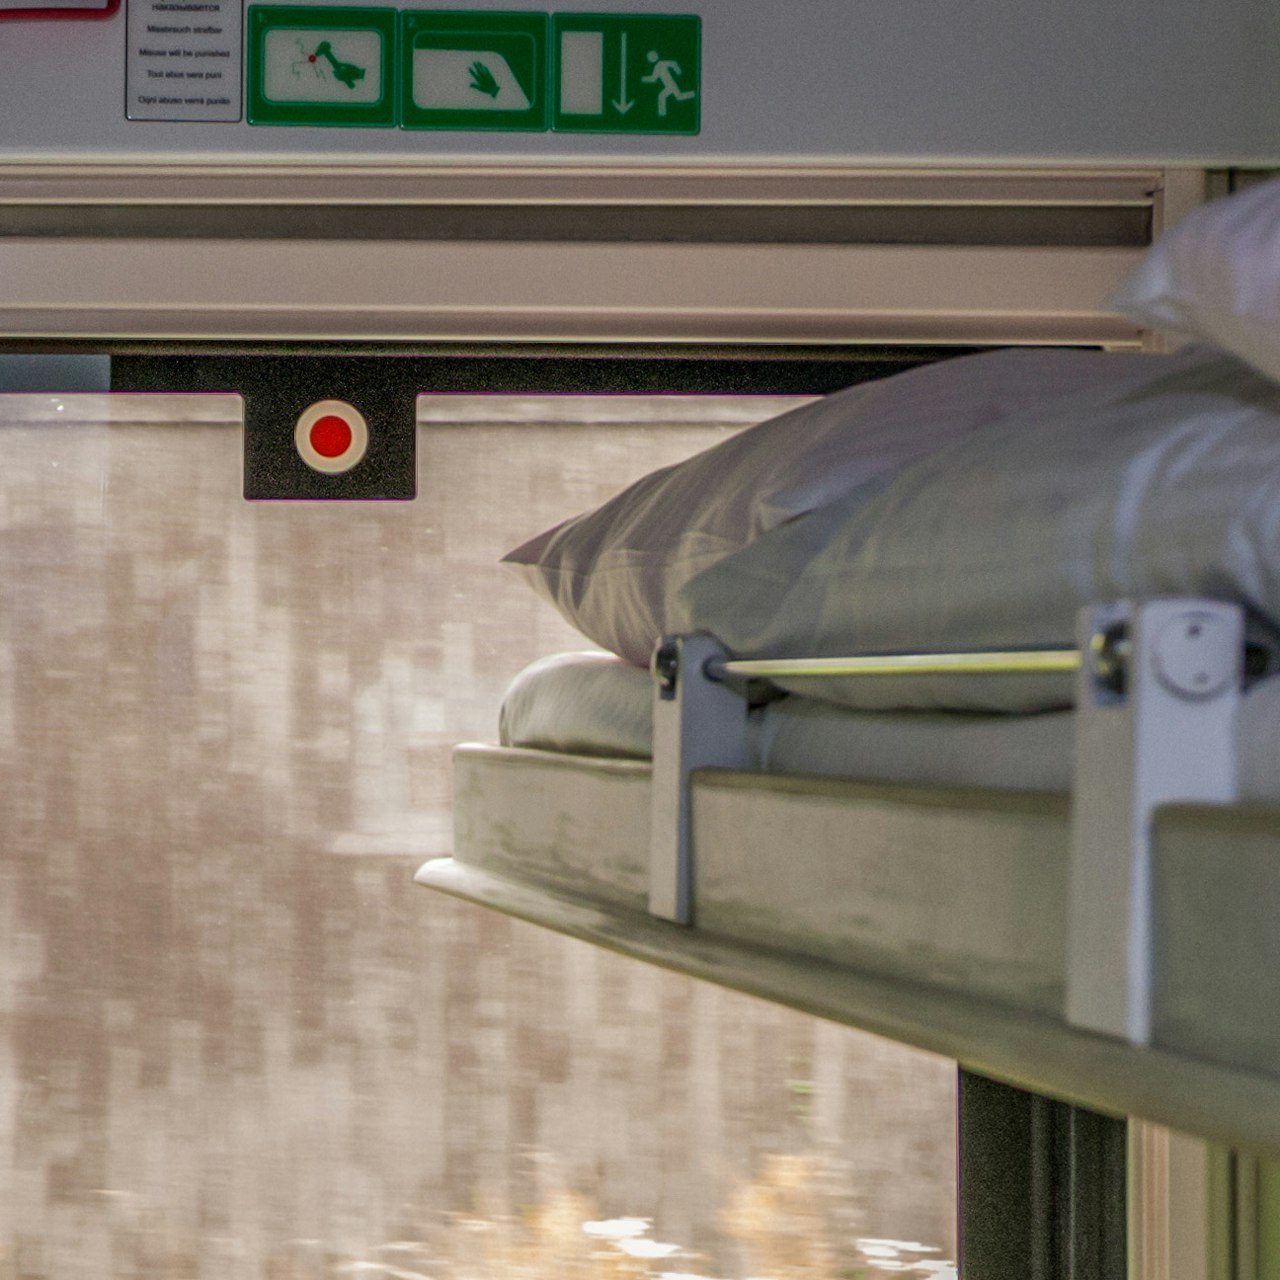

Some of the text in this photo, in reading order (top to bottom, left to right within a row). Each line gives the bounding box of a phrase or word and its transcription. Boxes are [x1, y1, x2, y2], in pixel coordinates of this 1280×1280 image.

[139, 49, 230, 59] Misuse will be punished
[205, 71, 222, 80] puni
